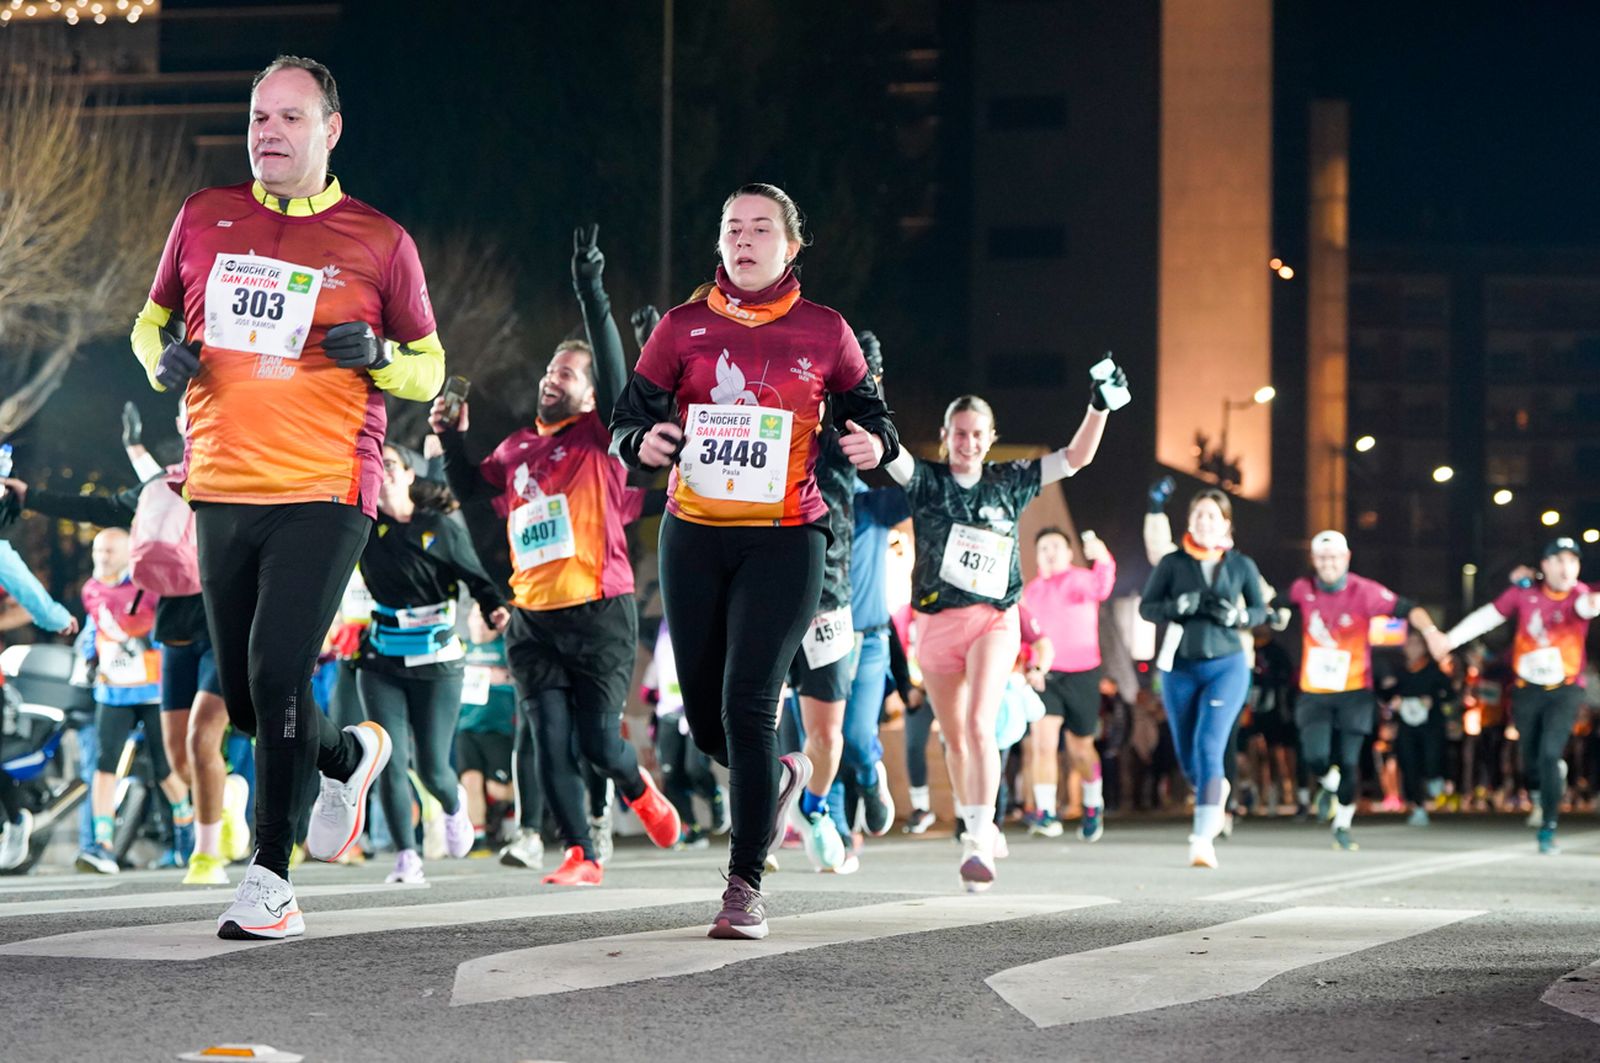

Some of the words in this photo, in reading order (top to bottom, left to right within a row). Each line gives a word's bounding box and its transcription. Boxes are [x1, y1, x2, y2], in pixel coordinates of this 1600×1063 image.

[236, 265, 266, 276] NOCHE
[268, 270, 281, 278] DE
[221, 274, 241, 284] SAN
[243, 276, 279, 289] ANTÓN
[232, 287, 285, 320] 303
[710, 416, 738, 425] NOCHE
[740, 417, 751, 425] DE
[696, 427, 716, 437] SAN
[717, 426, 751, 437] ANTÓN
[700, 438, 767, 468] 3448
[722, 468, 740, 476] Paula
[959, 550, 996, 574] 4372
